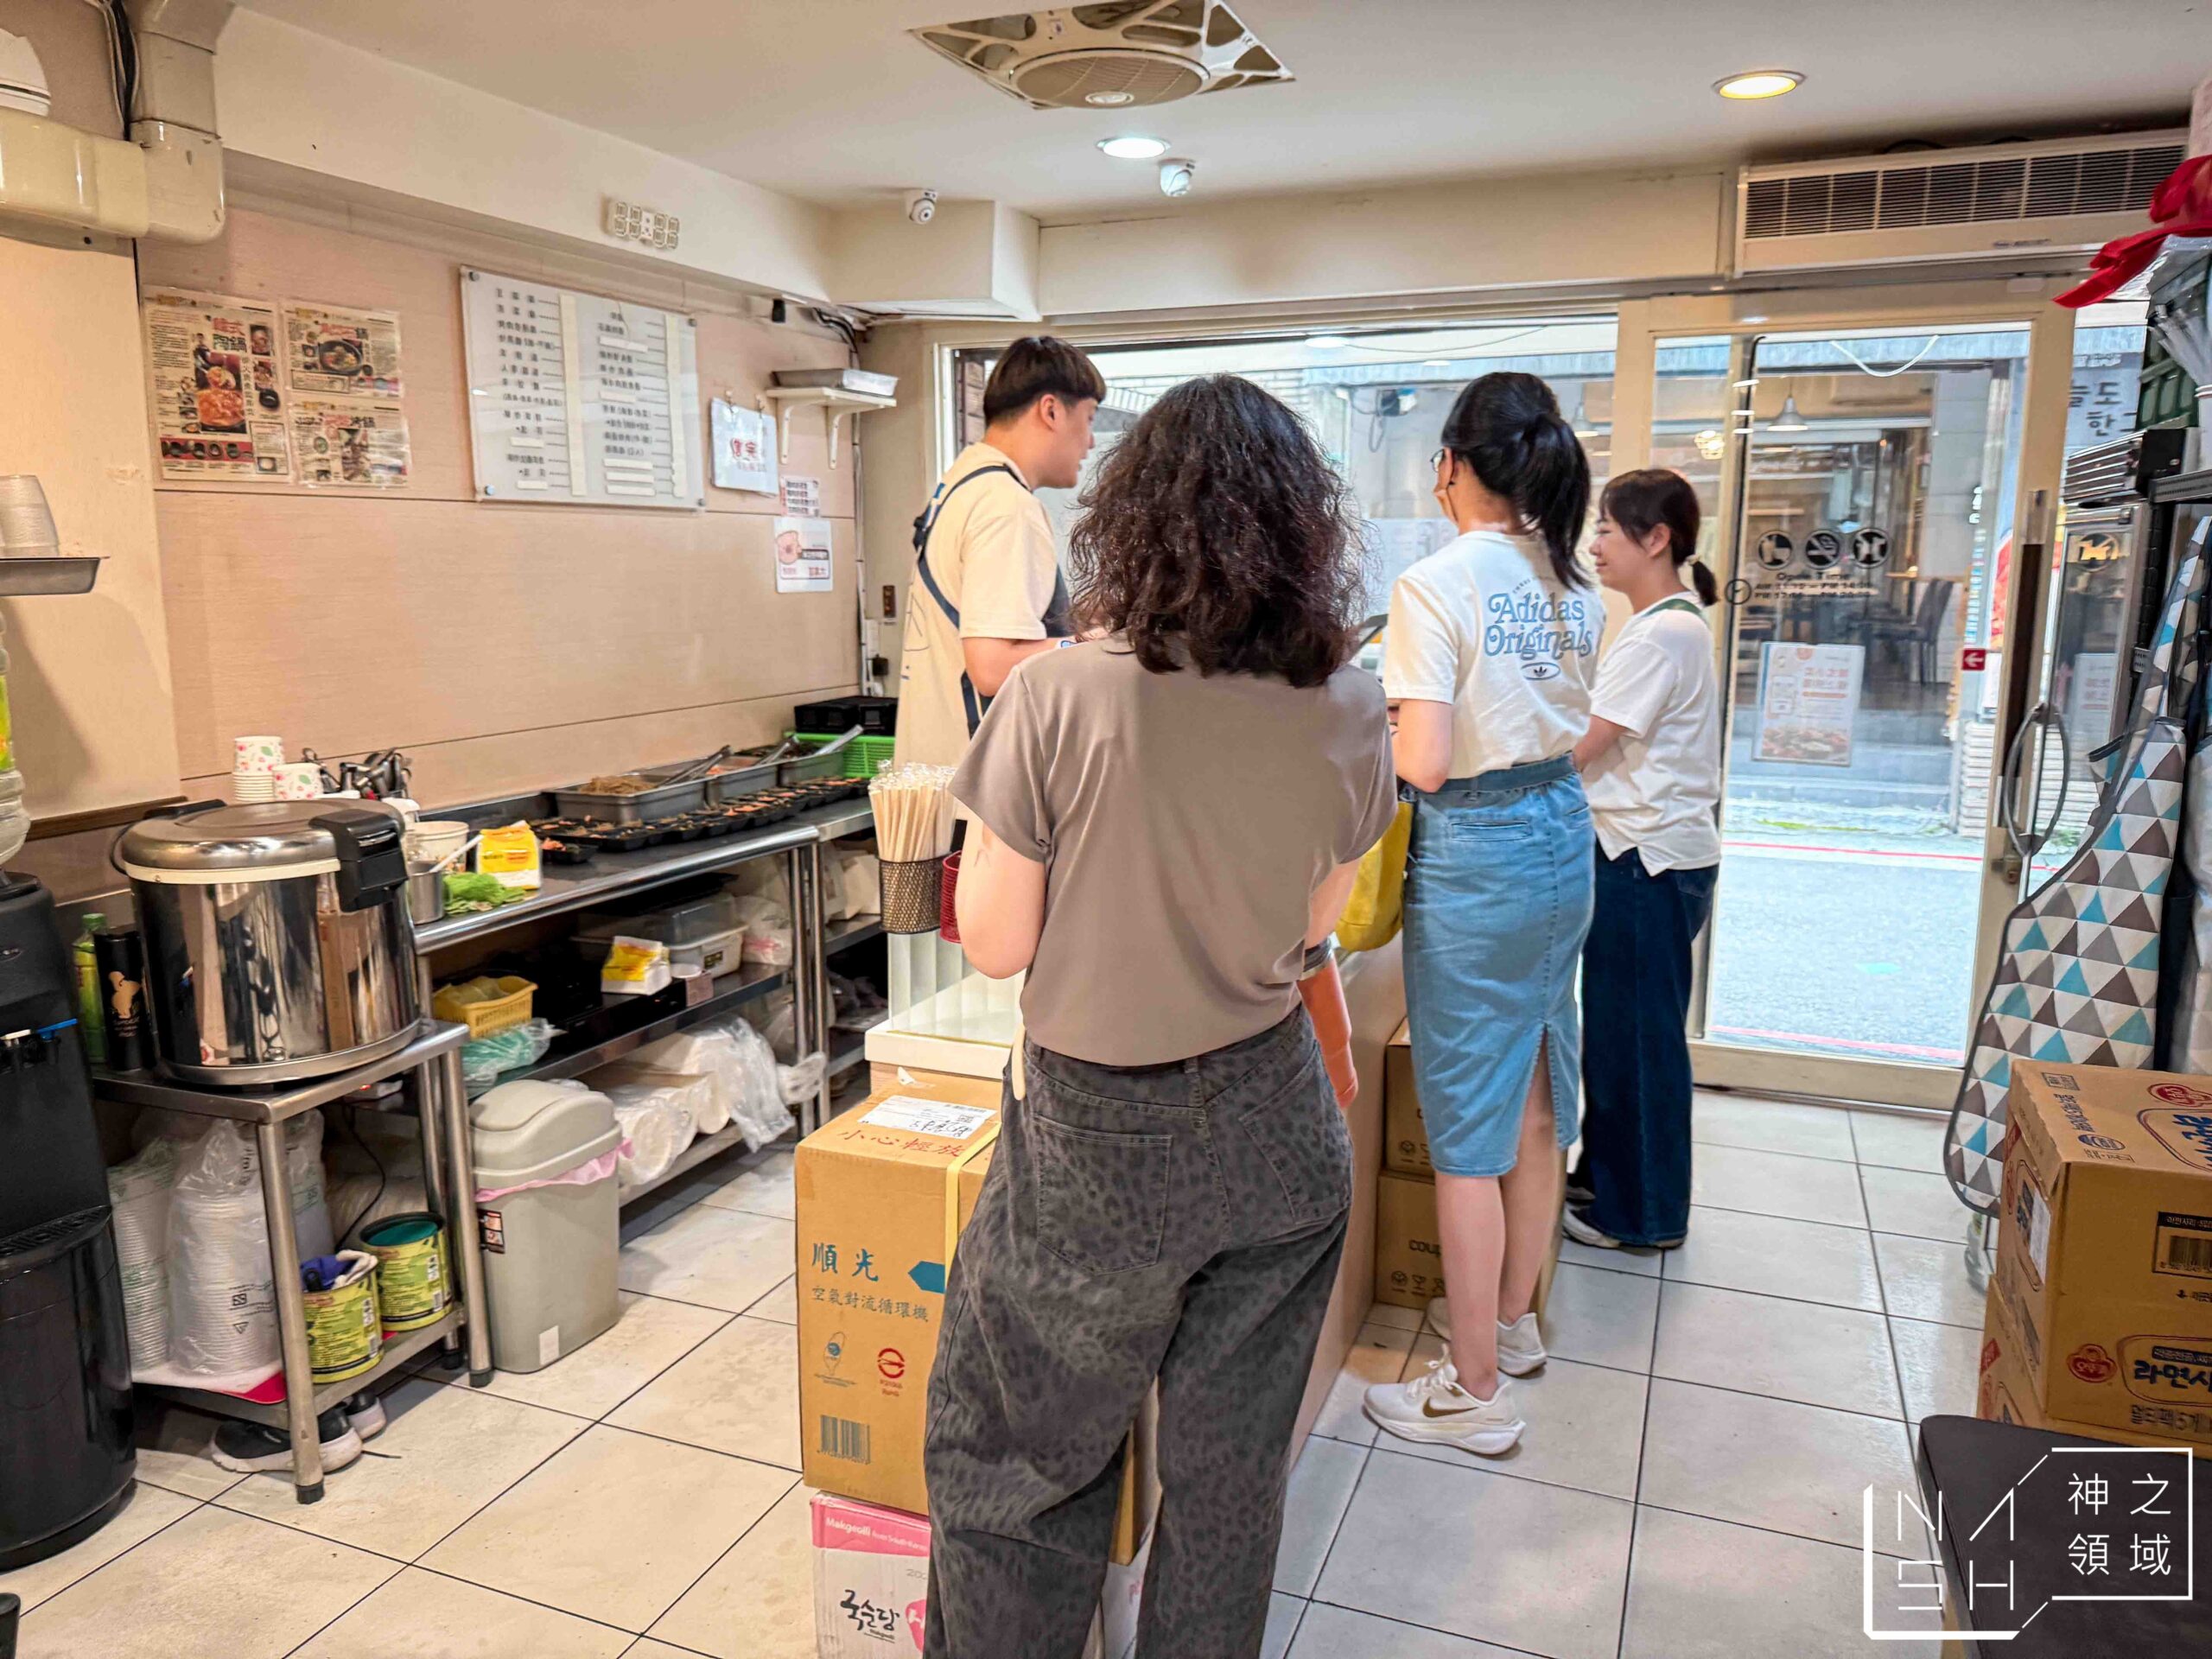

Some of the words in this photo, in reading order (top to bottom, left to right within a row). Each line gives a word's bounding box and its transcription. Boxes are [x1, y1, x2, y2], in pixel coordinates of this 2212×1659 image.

[1488, 592, 1585, 624] Adidas
[1484, 620, 1593, 661] Originals
[811, 1243, 879, 1283] 順光
[812, 1286, 929, 1323] 空氣對流循環機
